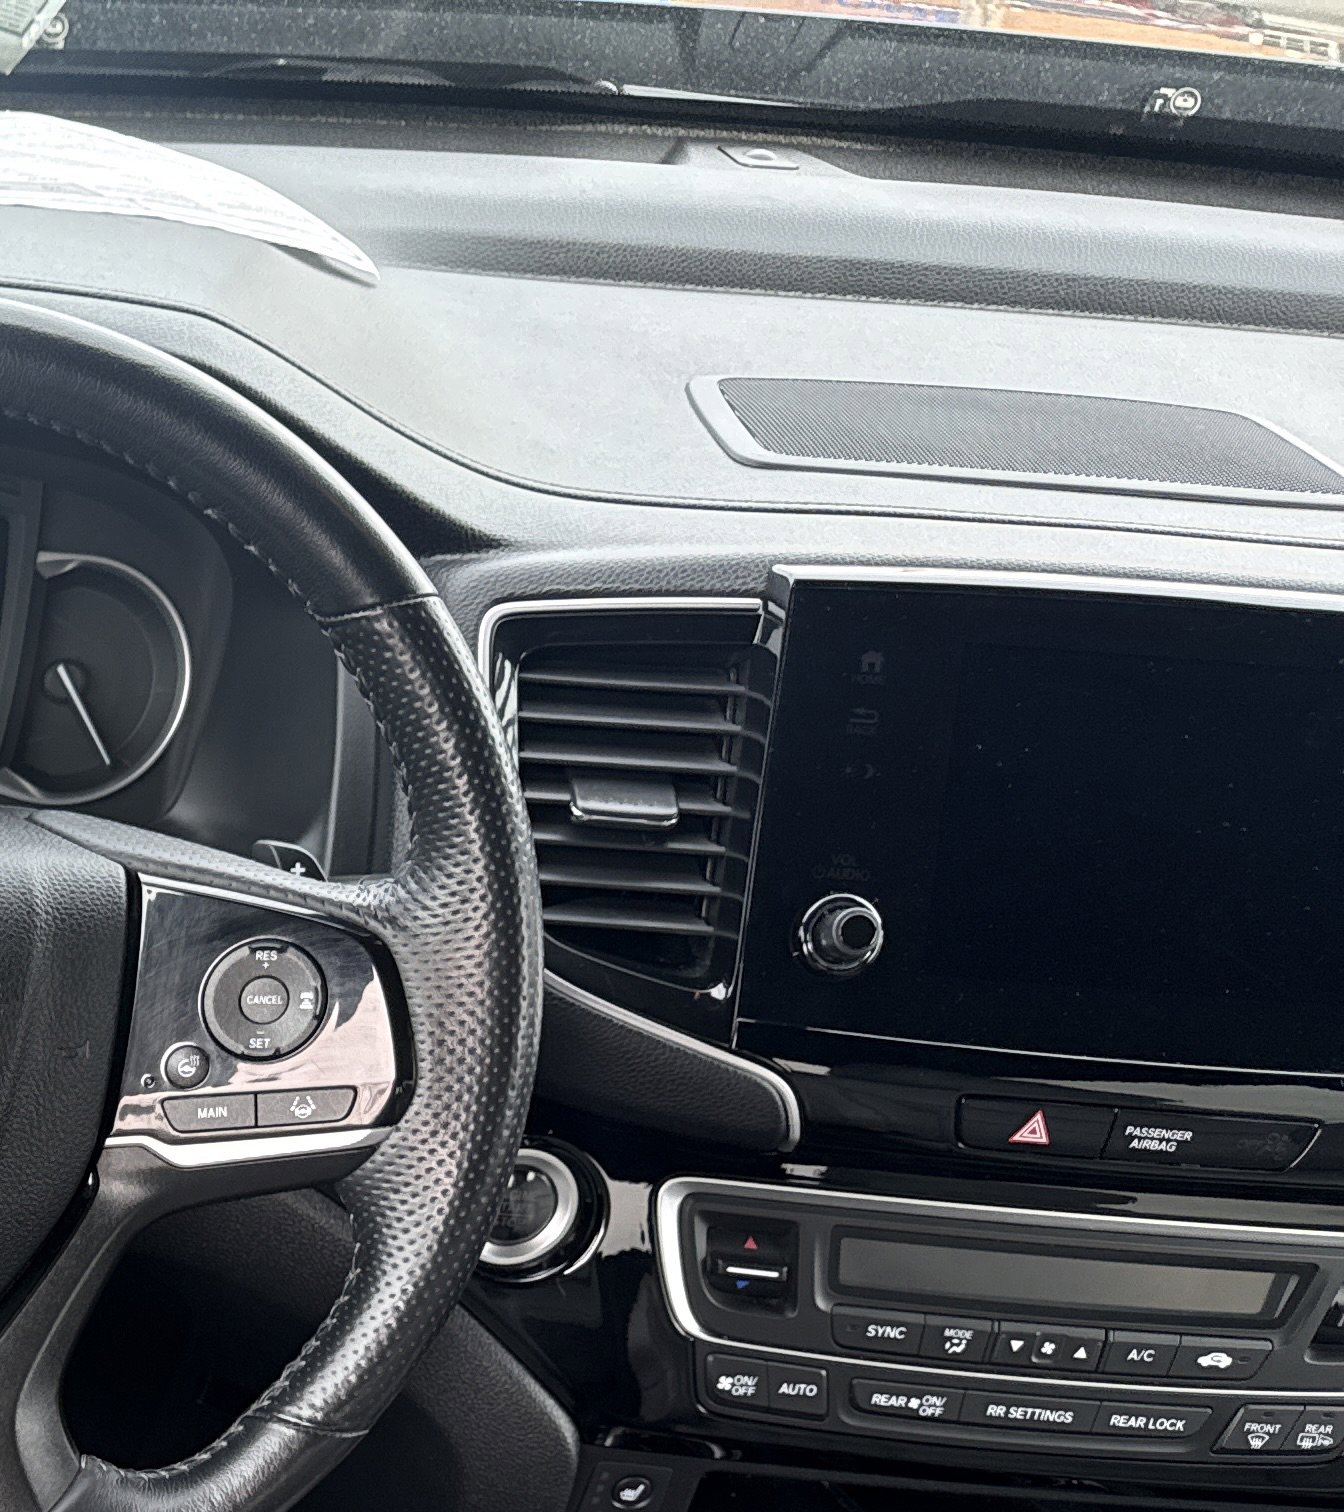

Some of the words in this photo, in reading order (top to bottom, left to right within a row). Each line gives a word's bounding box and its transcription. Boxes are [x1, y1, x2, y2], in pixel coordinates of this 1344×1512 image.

[255, 951, 278, 962] RES
[246, 994, 283, 1005] CANCEL
[249, 1038, 271, 1050] SET
[197, 1106, 228, 1119] MAIN
[1125, 1126, 1193, 1142] PASSENGER
[1129, 1139, 1178, 1152] AIRBAG
[866, 1324, 908, 1341] SYNC
[943, 1327, 974, 1340] MODE
[1127, 1348, 1155, 1363] A/C
[731, 1385, 756, 1397] OFF
[777, 1382, 818, 1397] AUTO
[870, 1393, 908, 1408] REAR
[918, 1405, 944, 1417] OFF
[986, 1404, 1006, 1417] RR
[1007, 1406, 1074, 1424] SETTINGS
[1110, 1415, 1146, 1428] REAR
[1148, 1417, 1186, 1432] LOCK
[1244, 1422, 1282, 1435] FRONT
[1304, 1423, 1334, 1435] REAR
